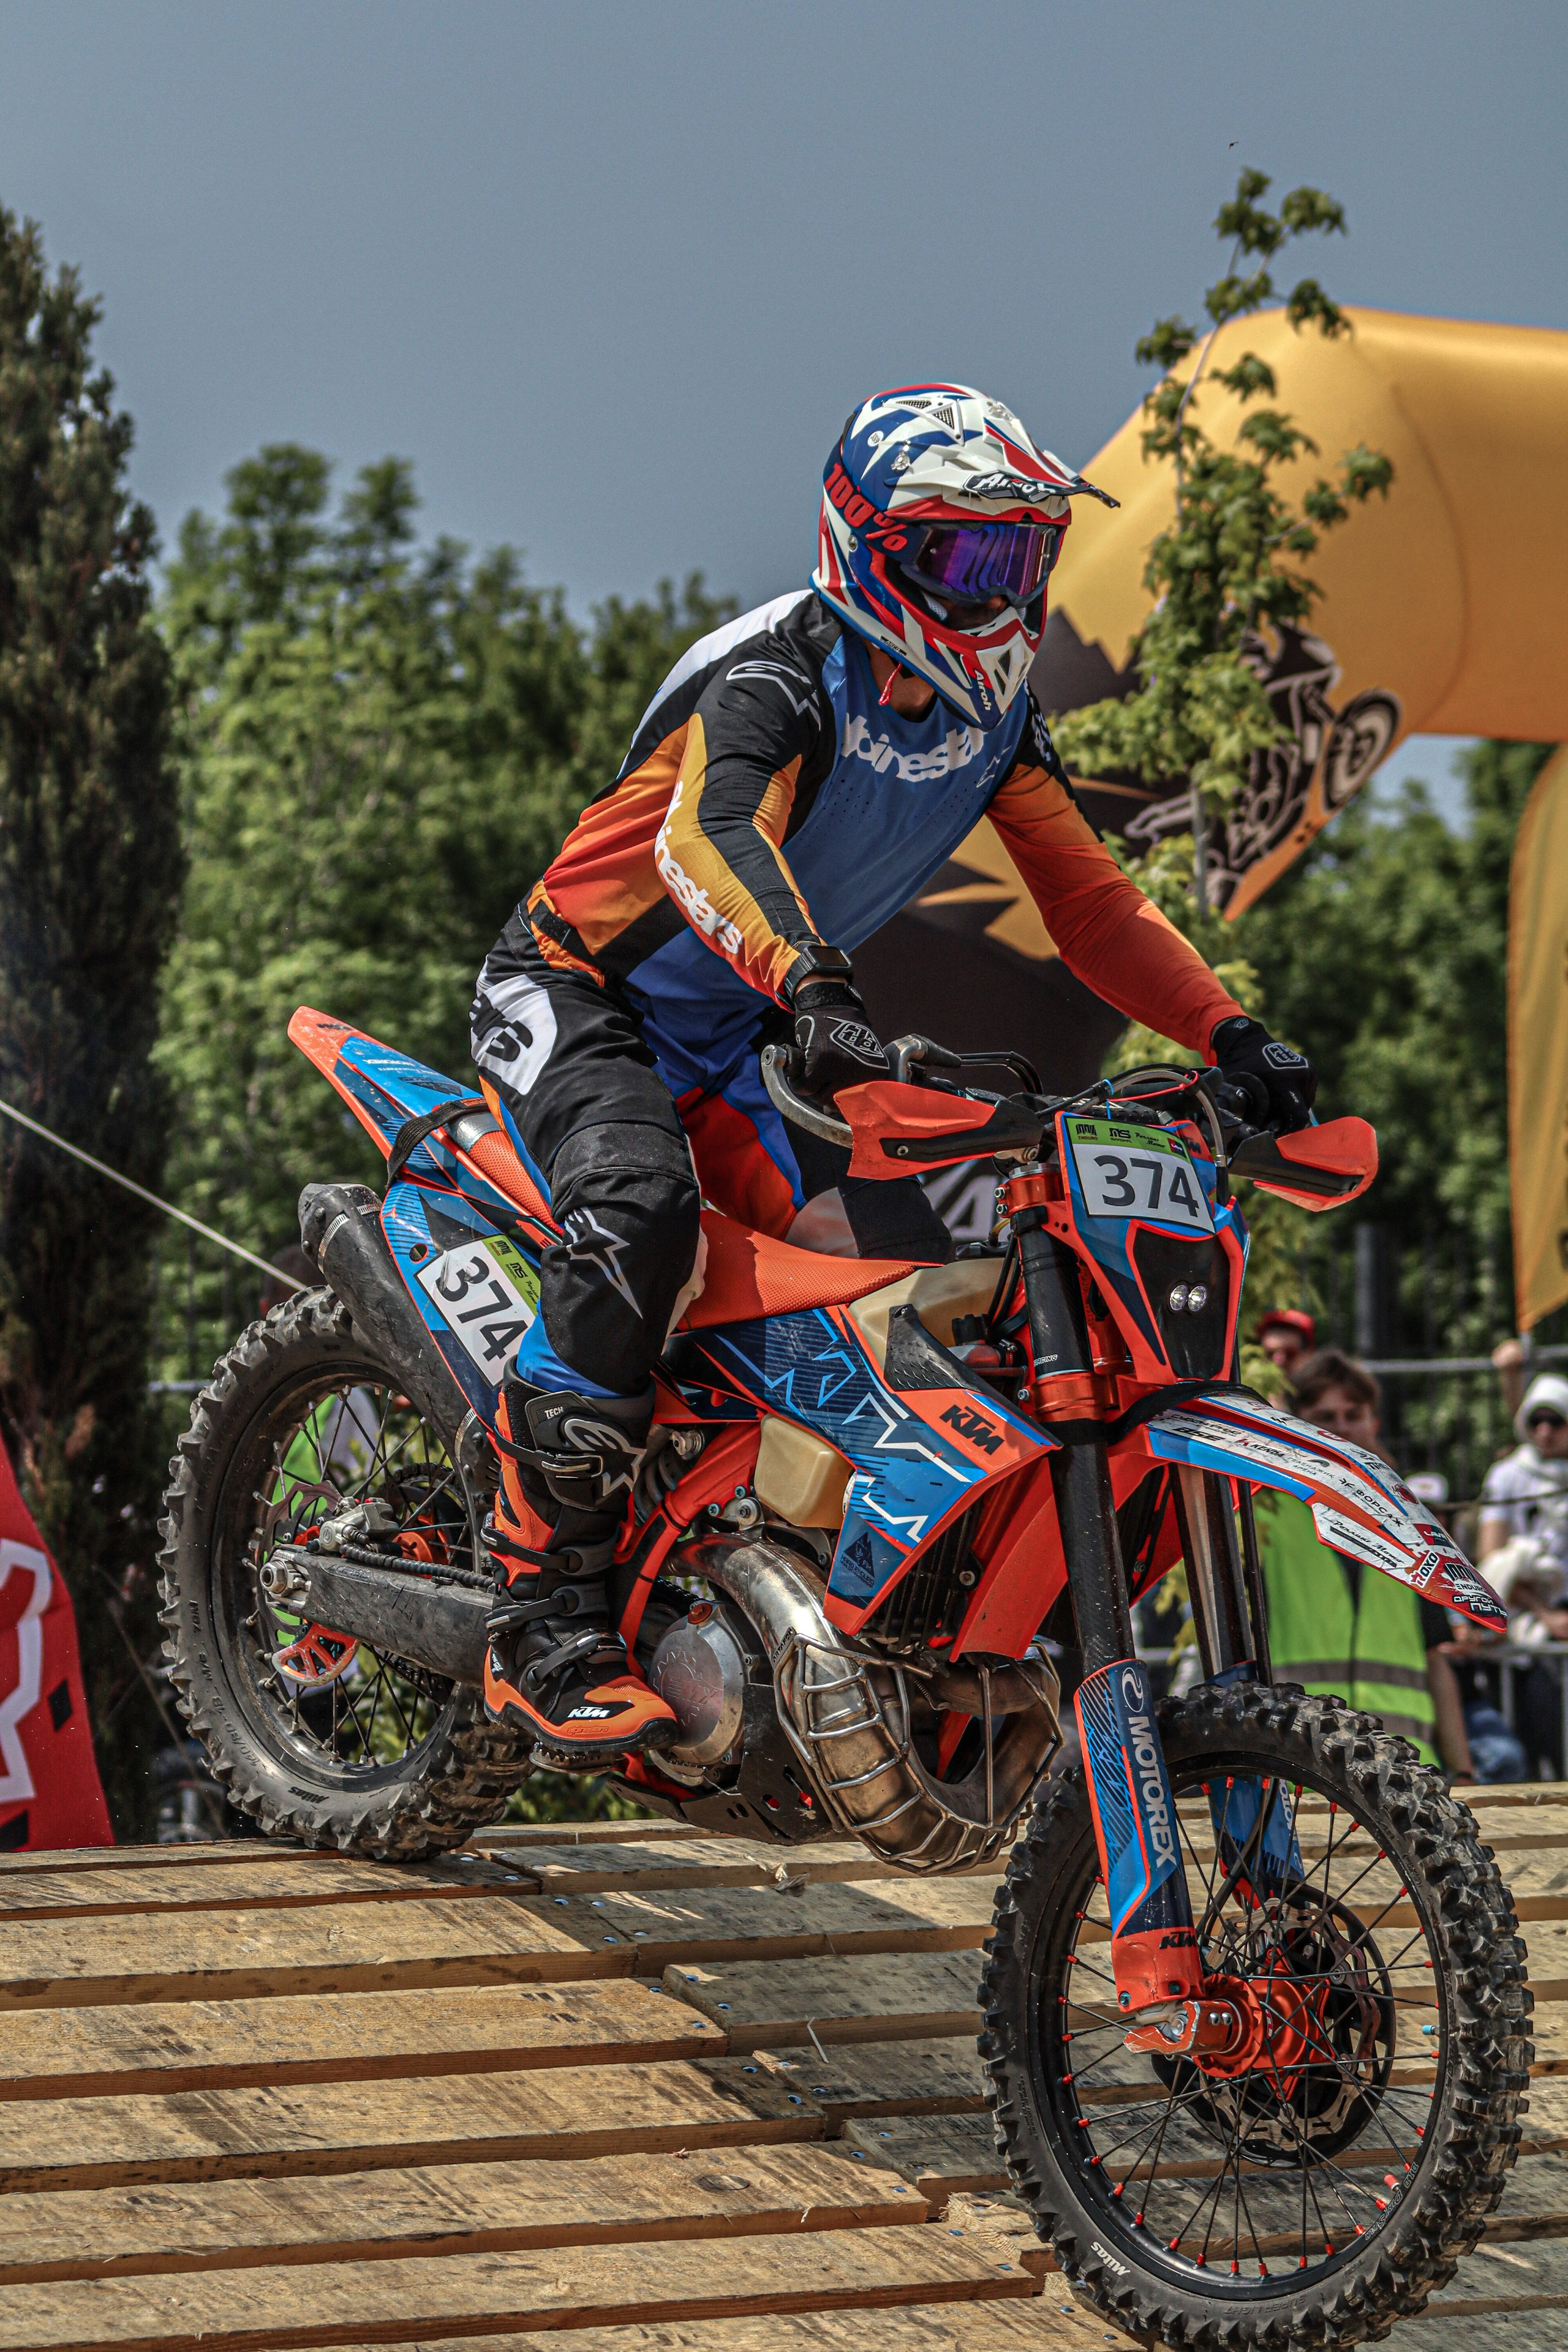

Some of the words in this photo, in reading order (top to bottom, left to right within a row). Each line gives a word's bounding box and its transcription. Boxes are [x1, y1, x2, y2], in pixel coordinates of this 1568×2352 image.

[823, 462, 908, 551] 100%
[1093, 1155, 1199, 1218] 374
[435, 1256, 529, 1362] 374
[545, 1406, 564, 1419] TECH
[939, 1404, 1005, 1455] KTM
[1250, 1443, 1286, 1458] KENDA
[1292, 1464, 1316, 1476] АРЕНА
[1356, 1489, 1404, 1528] ФОРСАЖ
[1411, 1553, 1438, 1586] ROKO
[1455, 1583, 1487, 1593] ENDURO
[1453, 1595, 1494, 1605] ДРУГОЙ
[1471, 1602, 1507, 1617] ПУТЬ
[567, 1706, 611, 1718] KTM
[567, 1725, 609, 1735] alpinestars
[1128, 1716, 1177, 1868] MOTOREX
[1159, 1931, 1196, 1950] KTM
[1090, 2241, 1131, 2277] Mitas
